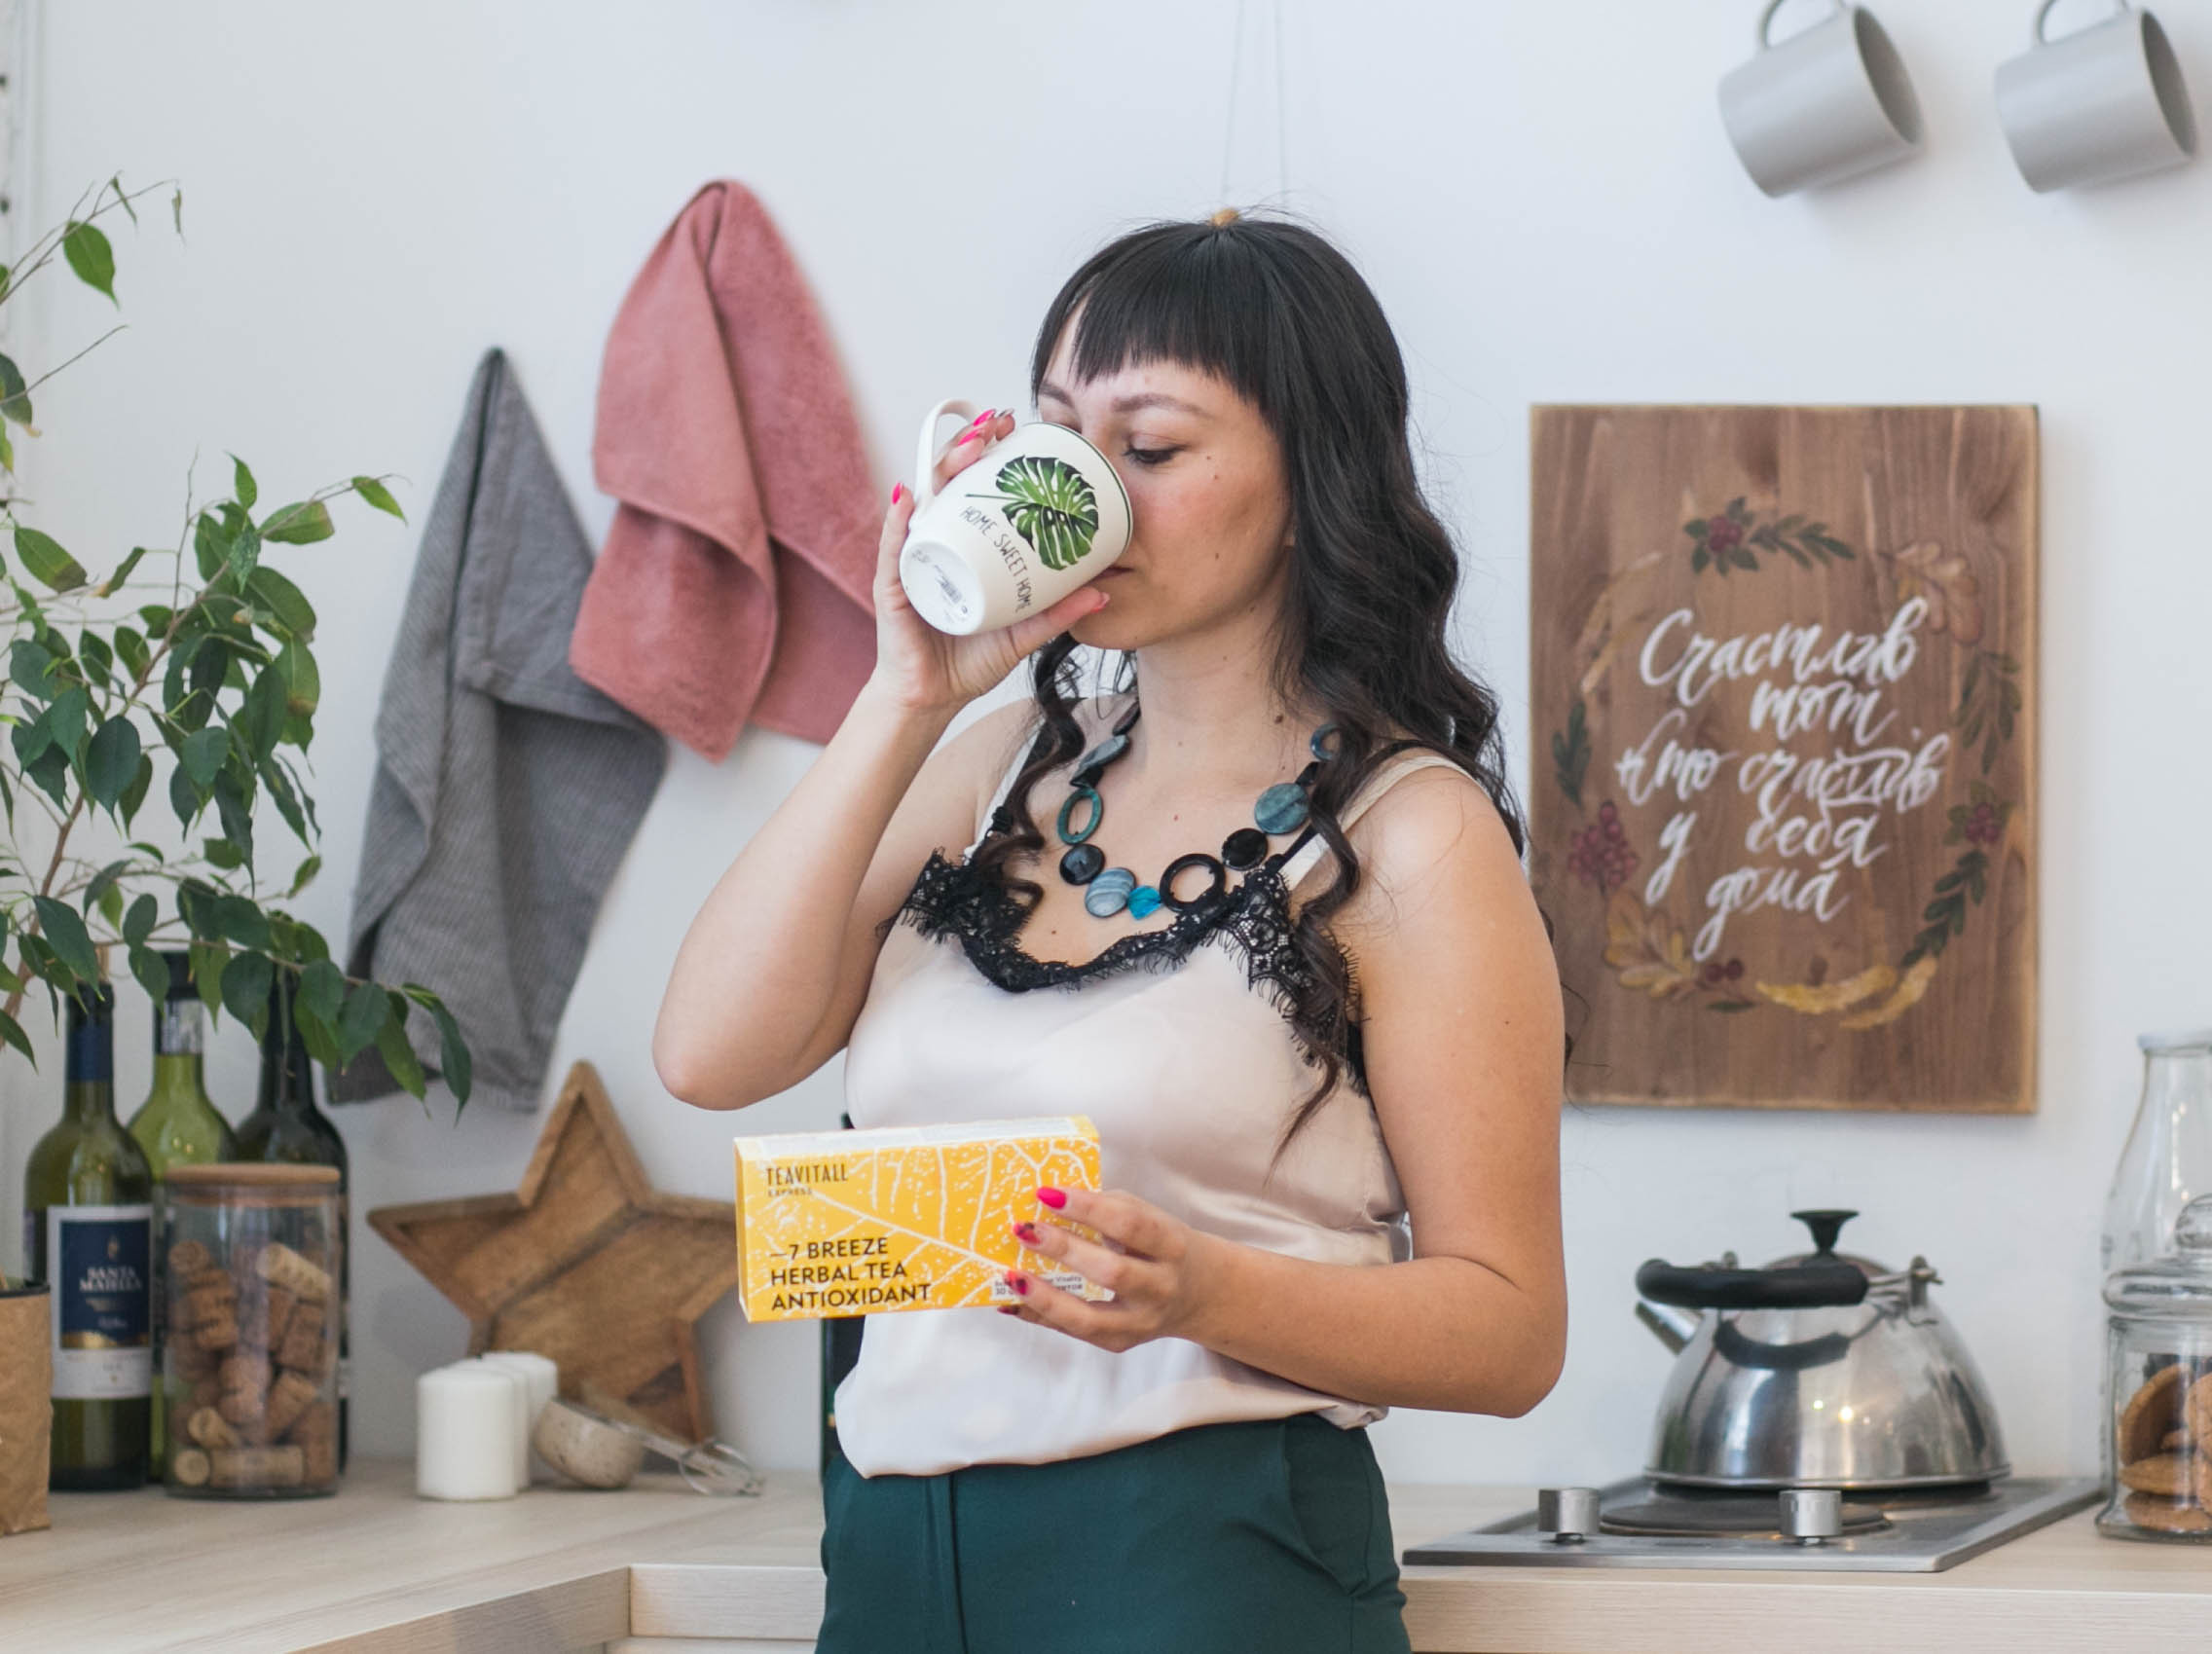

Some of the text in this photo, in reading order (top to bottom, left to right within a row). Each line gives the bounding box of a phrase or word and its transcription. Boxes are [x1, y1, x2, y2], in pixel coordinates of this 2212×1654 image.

[958, 505, 998, 536] HOME
[993, 533, 1028, 576] SWEET
[1640, 595, 1929, 708] Счастлив
[1749, 680, 1899, 748] тот
[1643, 800, 1890, 905] у себя
[1692, 864, 1852, 963] дома
[766, 1162, 849, 1186] TEAVITALL
[771, 1261, 907, 1285] HERBAL TEA
[807, 1236, 889, 1259] BREEZE
[771, 1283, 932, 1311] ANTIOXIDANT
